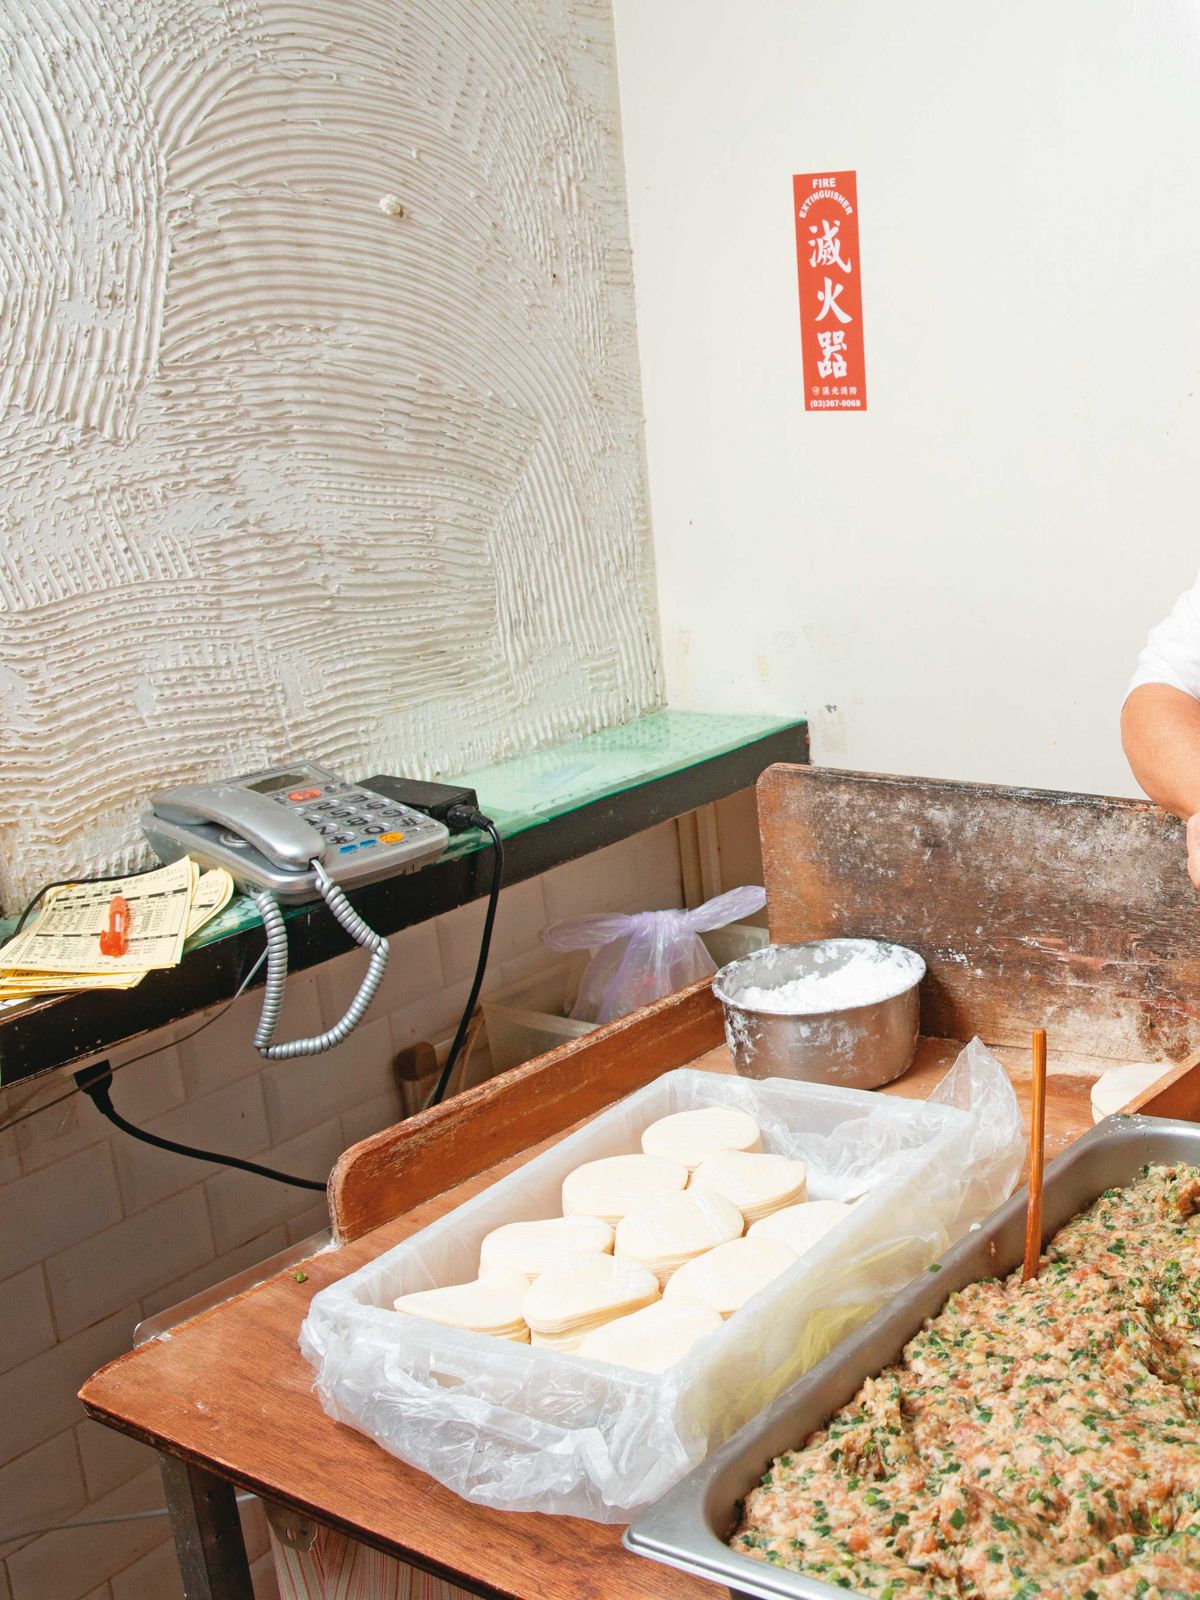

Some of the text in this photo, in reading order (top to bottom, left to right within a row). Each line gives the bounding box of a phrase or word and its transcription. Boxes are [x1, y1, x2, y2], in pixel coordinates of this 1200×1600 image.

[812, 177, 836, 189] FIRE
[799, 190, 853, 219] EXTINGUISHER
[808, 218, 853, 379] 滅火器
[330, 809, 352, 818] 5
[366, 801, 386, 810] 6
[346, 817, 369, 826] 8
[382, 809, 403, 818] 9
